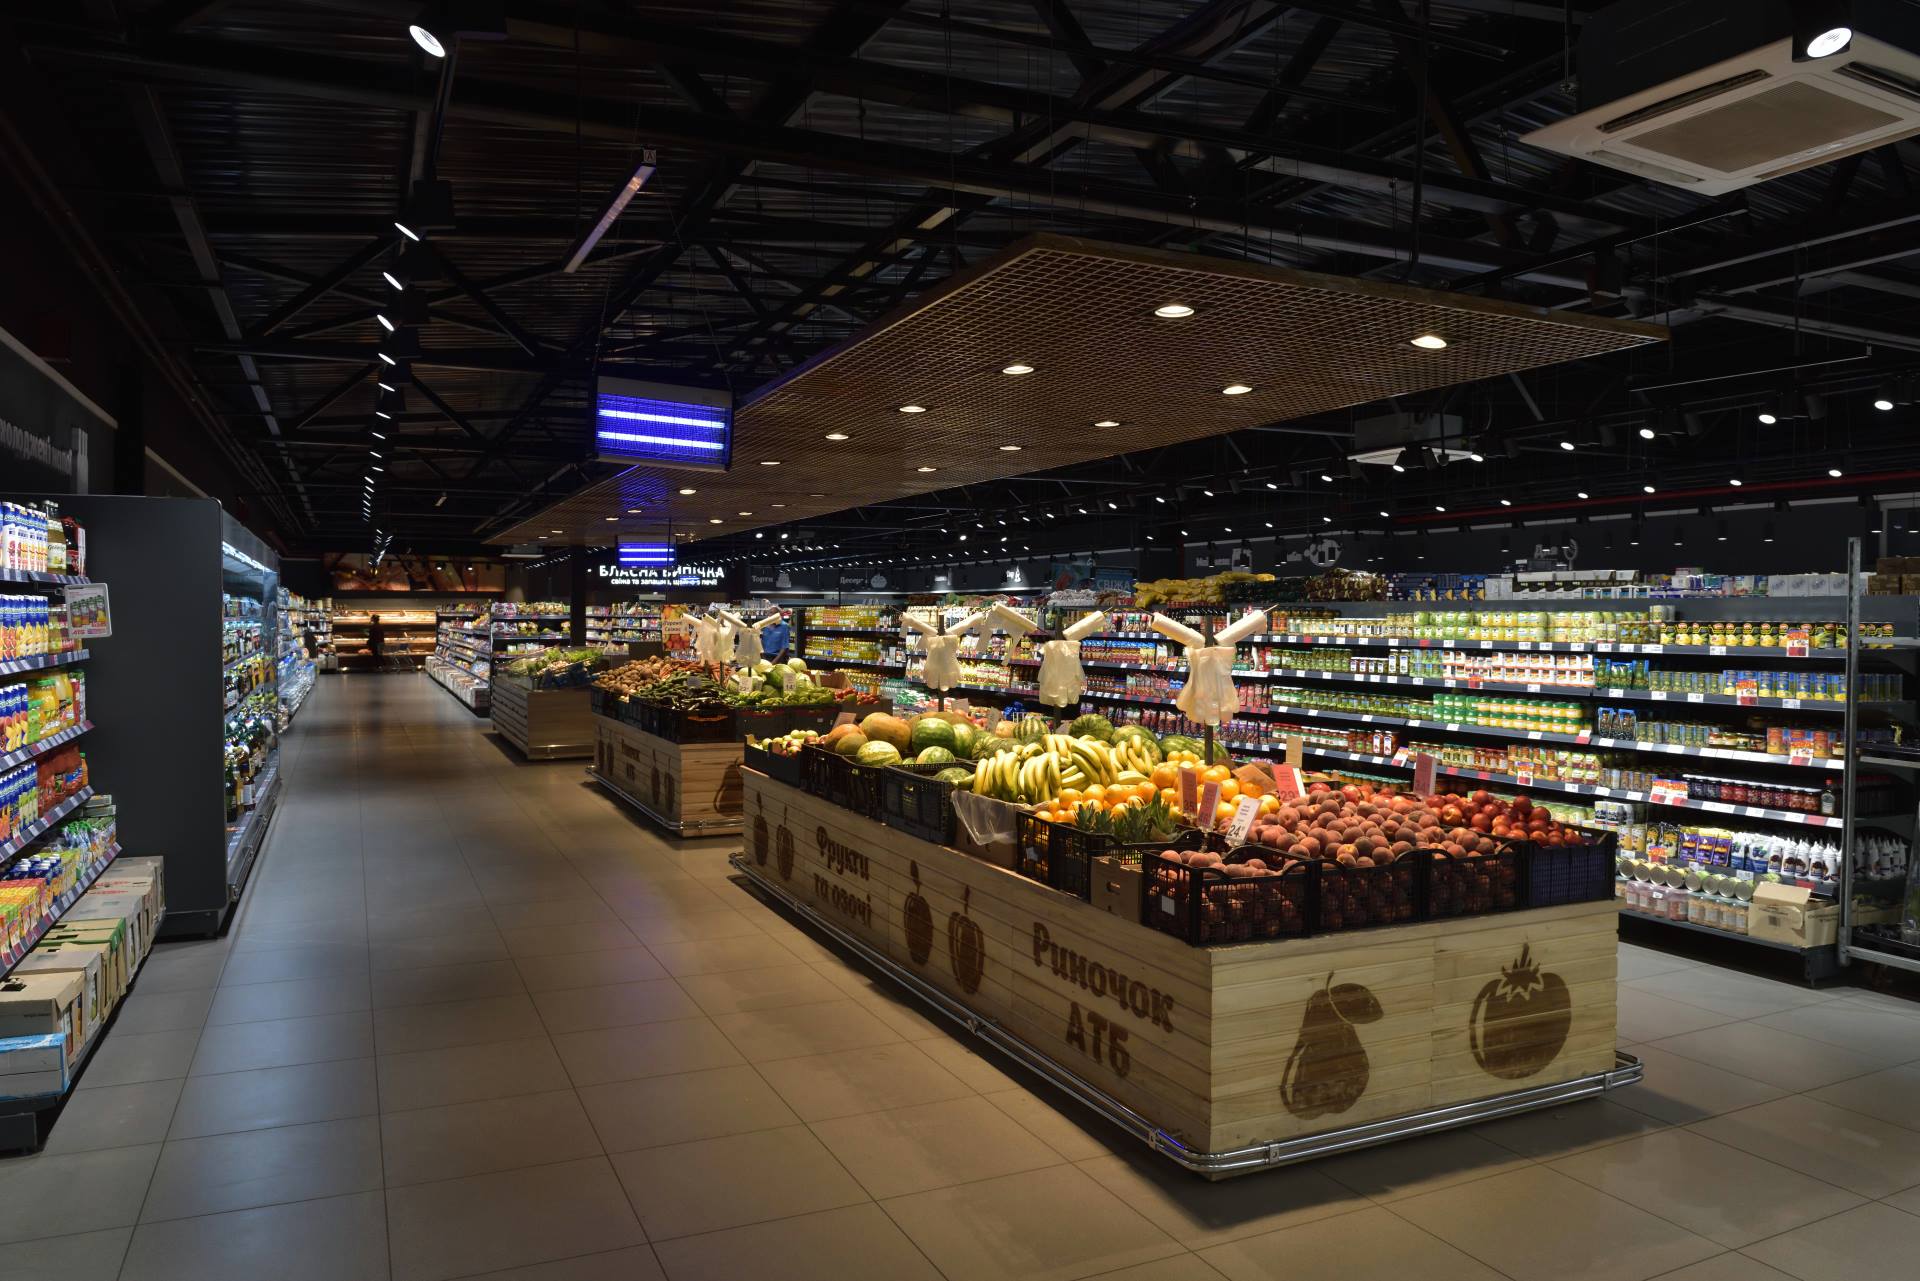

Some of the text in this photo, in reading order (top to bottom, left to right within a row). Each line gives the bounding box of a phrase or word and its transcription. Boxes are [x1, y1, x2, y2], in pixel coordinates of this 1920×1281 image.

[817, 826, 870, 881] Фрукти
[1228, 824, 1241, 837] 24
[1033, 921, 1175, 1033] Риночок
[1066, 1001, 1132, 1078] АТБ
